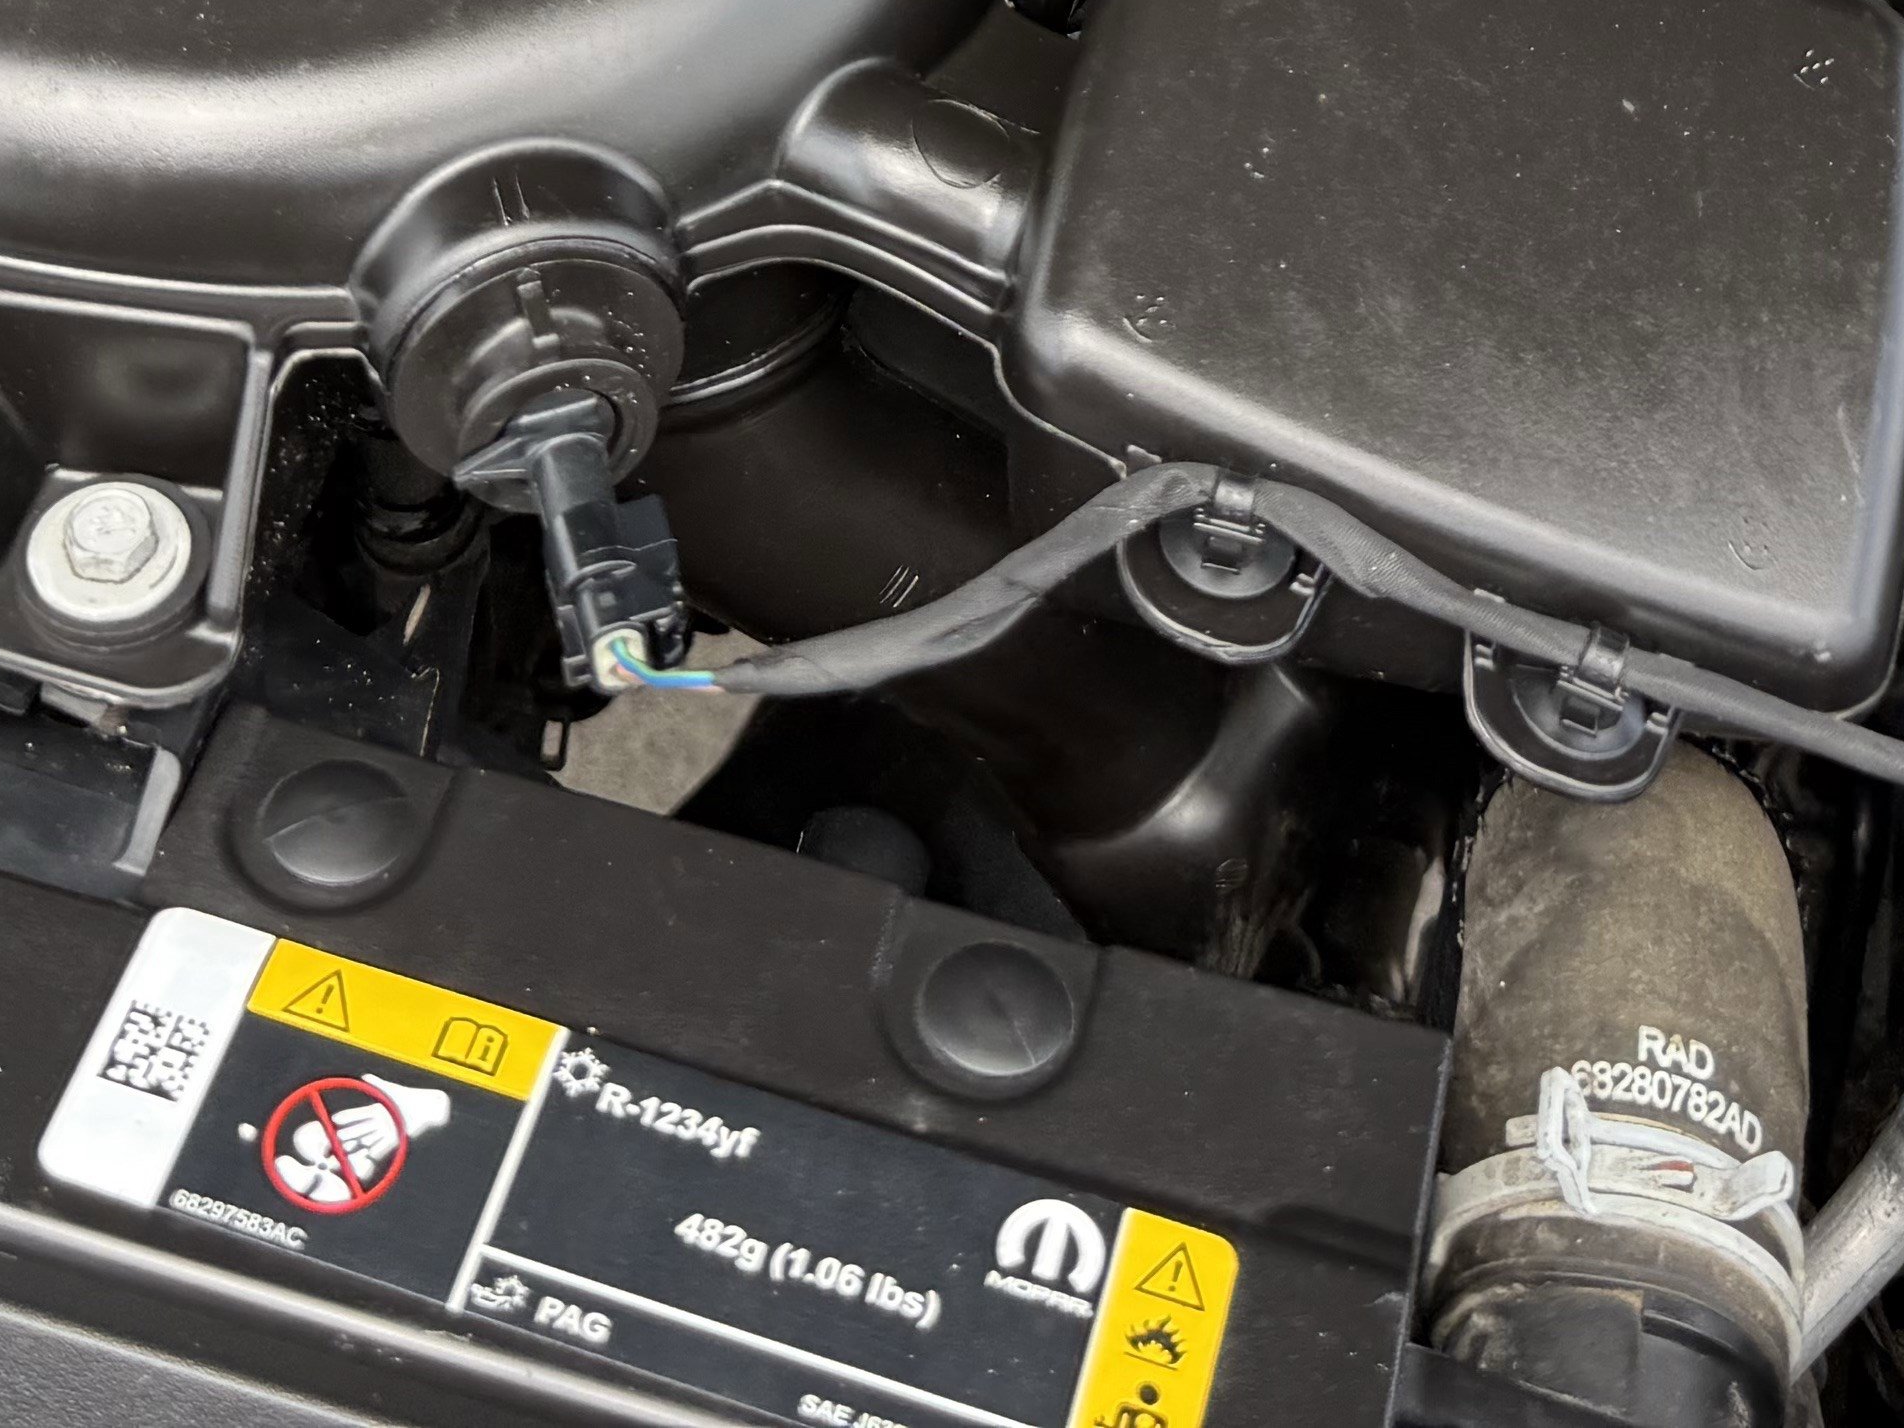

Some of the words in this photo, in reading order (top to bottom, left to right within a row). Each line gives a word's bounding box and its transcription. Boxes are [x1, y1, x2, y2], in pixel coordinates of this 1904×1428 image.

[1637, 1025, 1715, 1081] RAD
[596, 1084, 761, 1158] R-1234yf
[1571, 1059, 1763, 1155] 68280782AD
[169, 1188, 309, 1251] 68297583AC
[674, 1213, 770, 1274] 482g
[770, 1242, 866, 1298] (1.06
[866, 1272, 942, 1331] lbs)
[983, 1269, 1094, 1319] MOPAR
[534, 1295, 614, 1343] PAG
[797, 1393, 856, 1427] SAE
